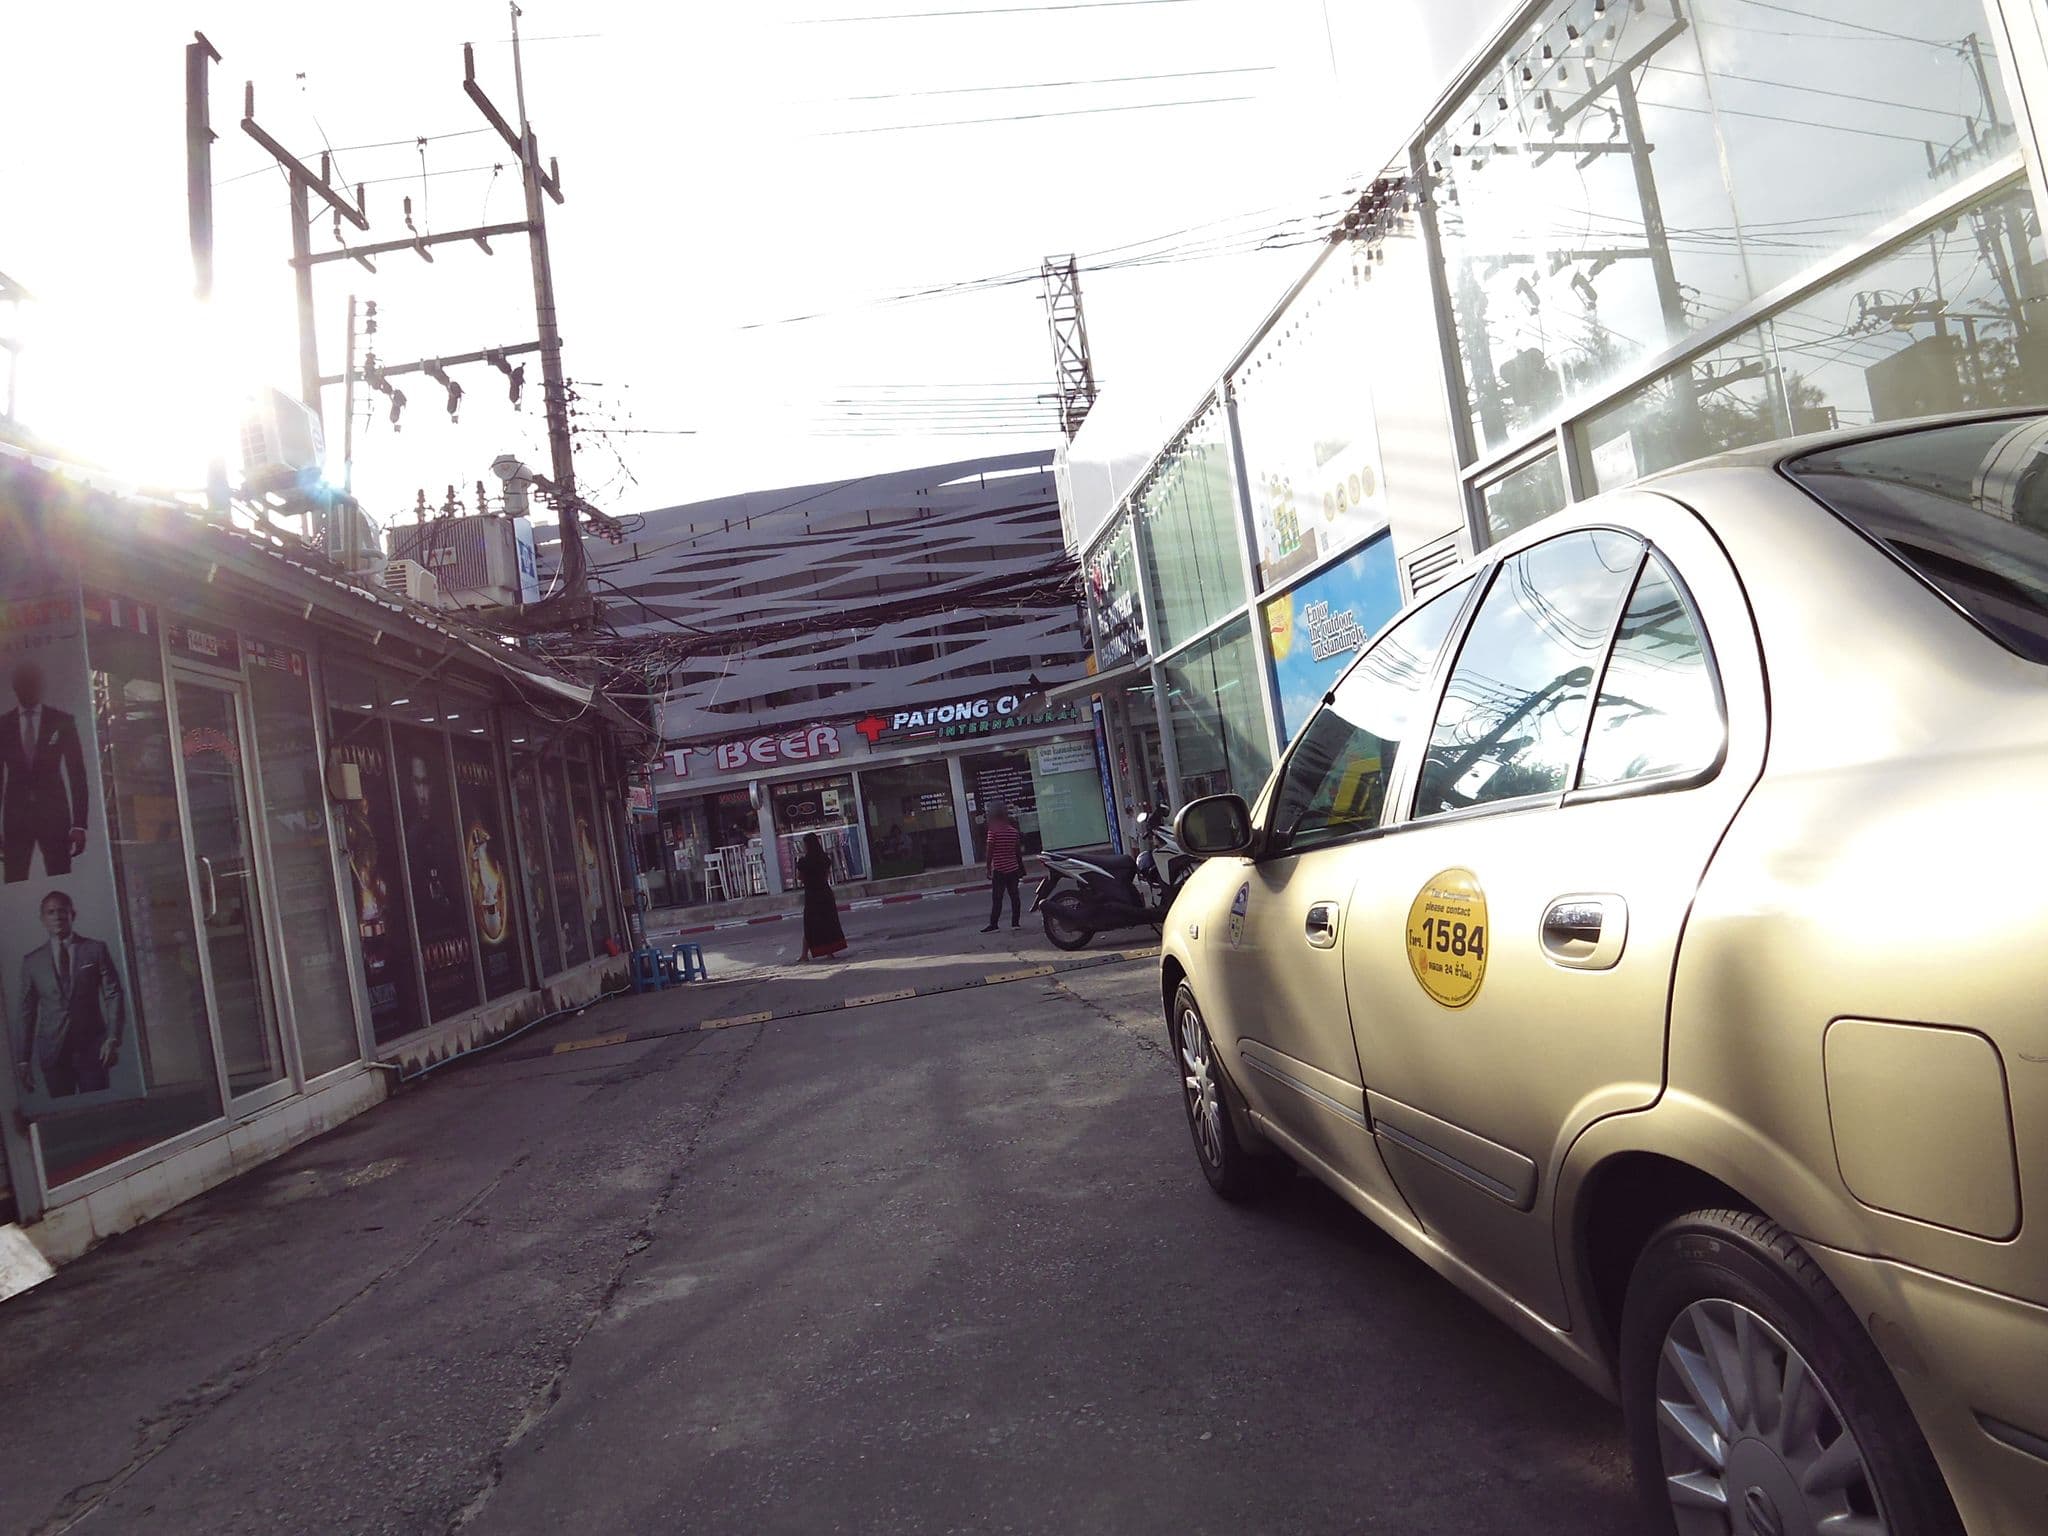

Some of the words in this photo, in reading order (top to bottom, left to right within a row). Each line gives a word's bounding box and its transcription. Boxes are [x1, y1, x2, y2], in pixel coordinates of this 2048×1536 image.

[1305, 601, 1328, 624] Enjoy
[1309, 622, 1322, 643] the
[1322, 610, 1353, 638] outdoor
[893, 699, 989, 730] PATONG
[938, 708, 1078, 737] INTERNATIONAL
[716, 726, 840, 770] BEER
[1425, 901, 1444, 913] please
[1446, 904, 1471, 917] contact
[1422, 917, 1484, 961] 1584
[1444, 963, 1453, 975] 24
